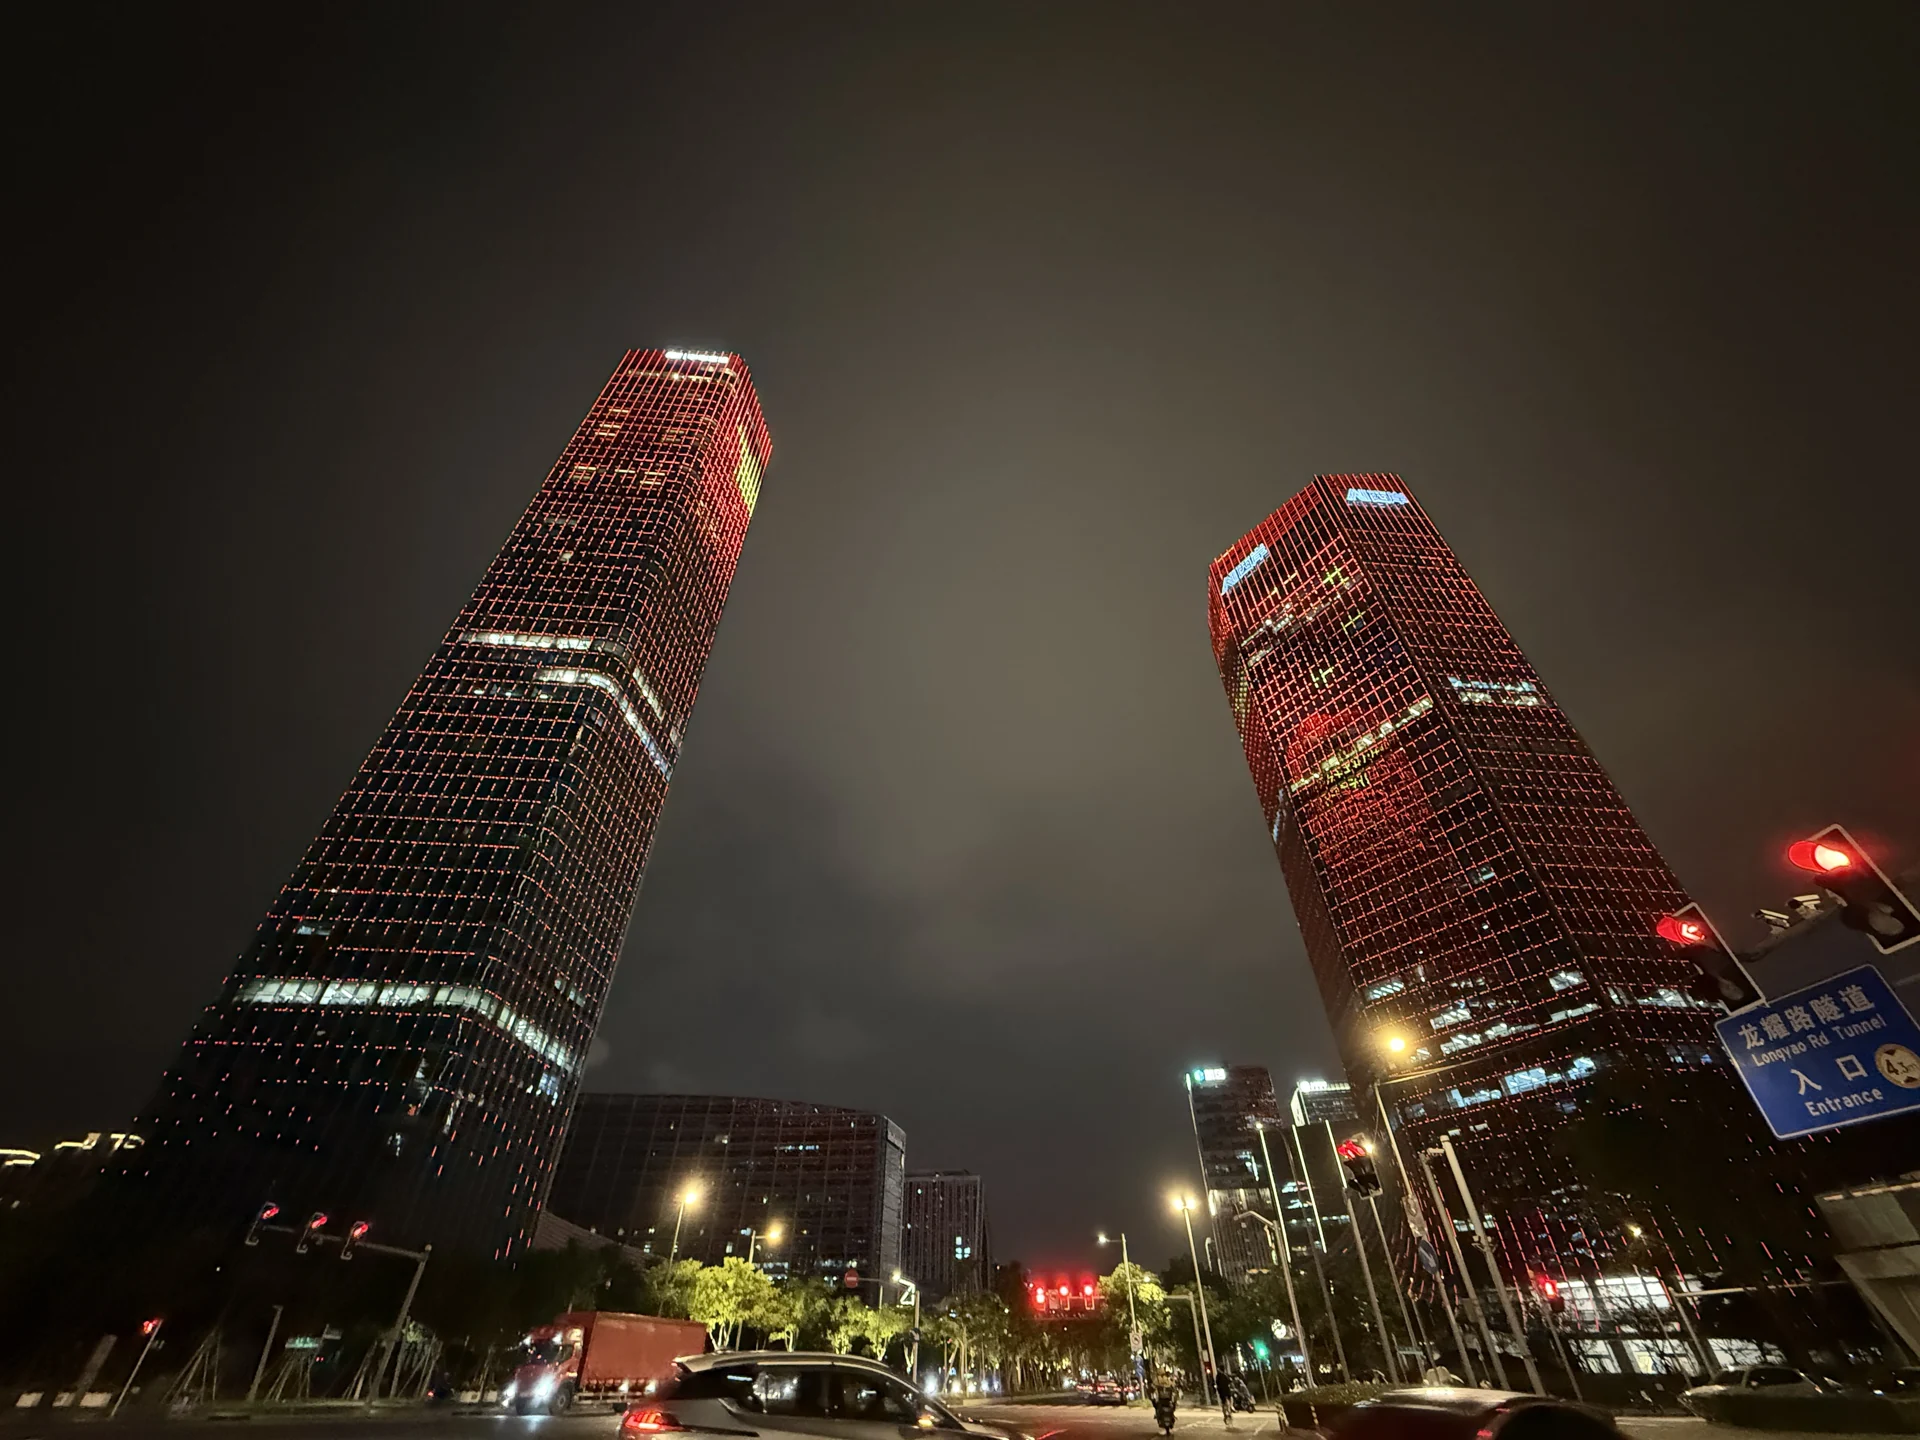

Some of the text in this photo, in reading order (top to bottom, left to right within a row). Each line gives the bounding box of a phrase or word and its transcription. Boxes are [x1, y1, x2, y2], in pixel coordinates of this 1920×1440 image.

[1738, 984, 1875, 1050] 龙耀路隧道
[1751, 1013, 1888, 1067] Longyao Rd Tunnel
[1805, 1086, 1884, 1117] Entrance
